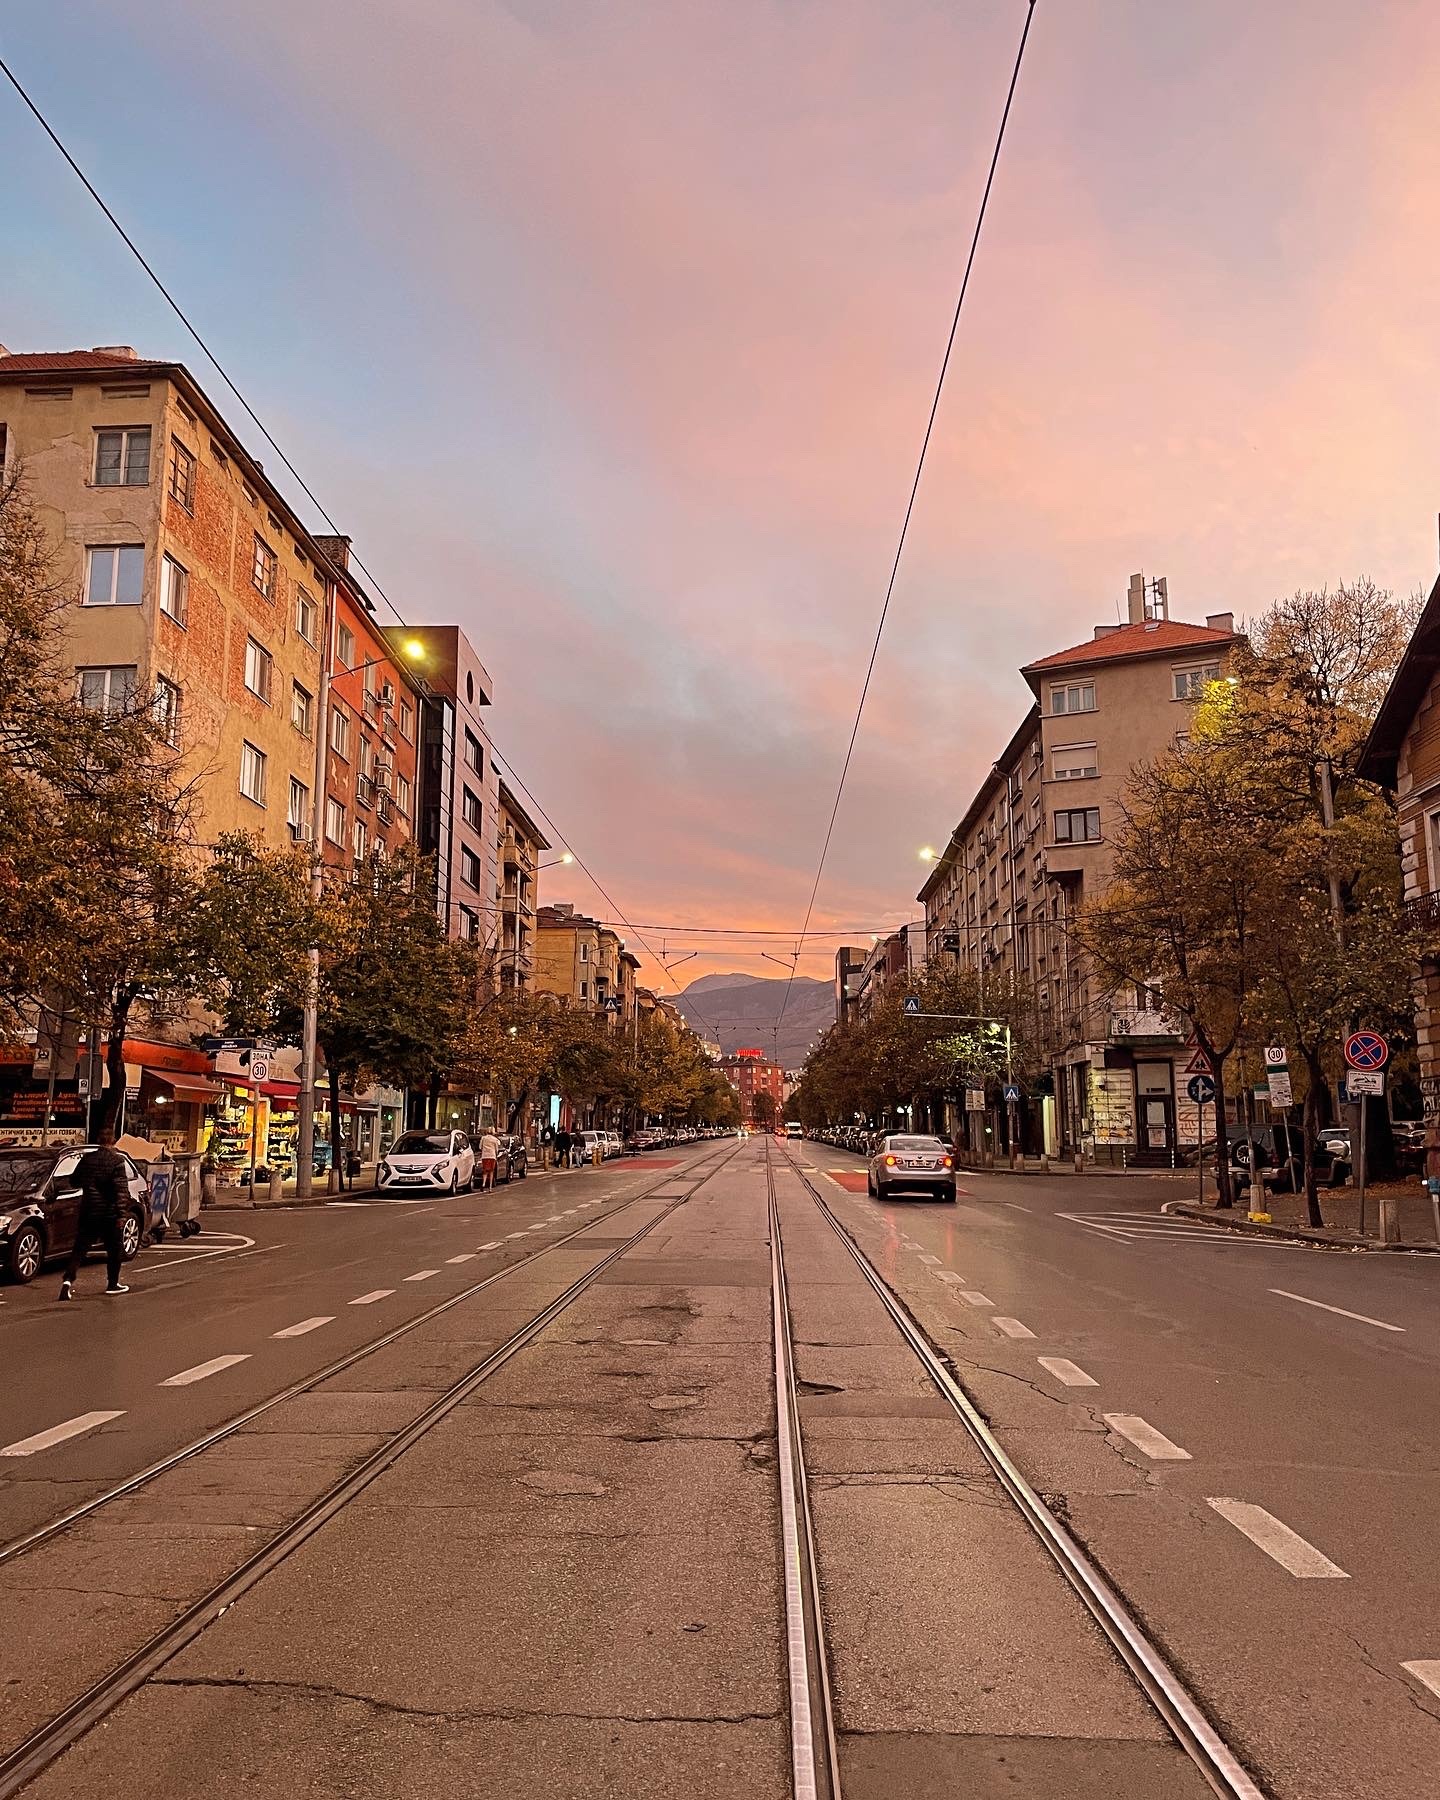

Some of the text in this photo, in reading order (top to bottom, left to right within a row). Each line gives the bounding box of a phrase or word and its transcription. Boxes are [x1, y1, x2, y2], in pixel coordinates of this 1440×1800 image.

[252, 1052, 269, 1060] ЗОНА
[1270, 1050, 1280, 1059] 30
[255, 1065, 264, 1076] 30
